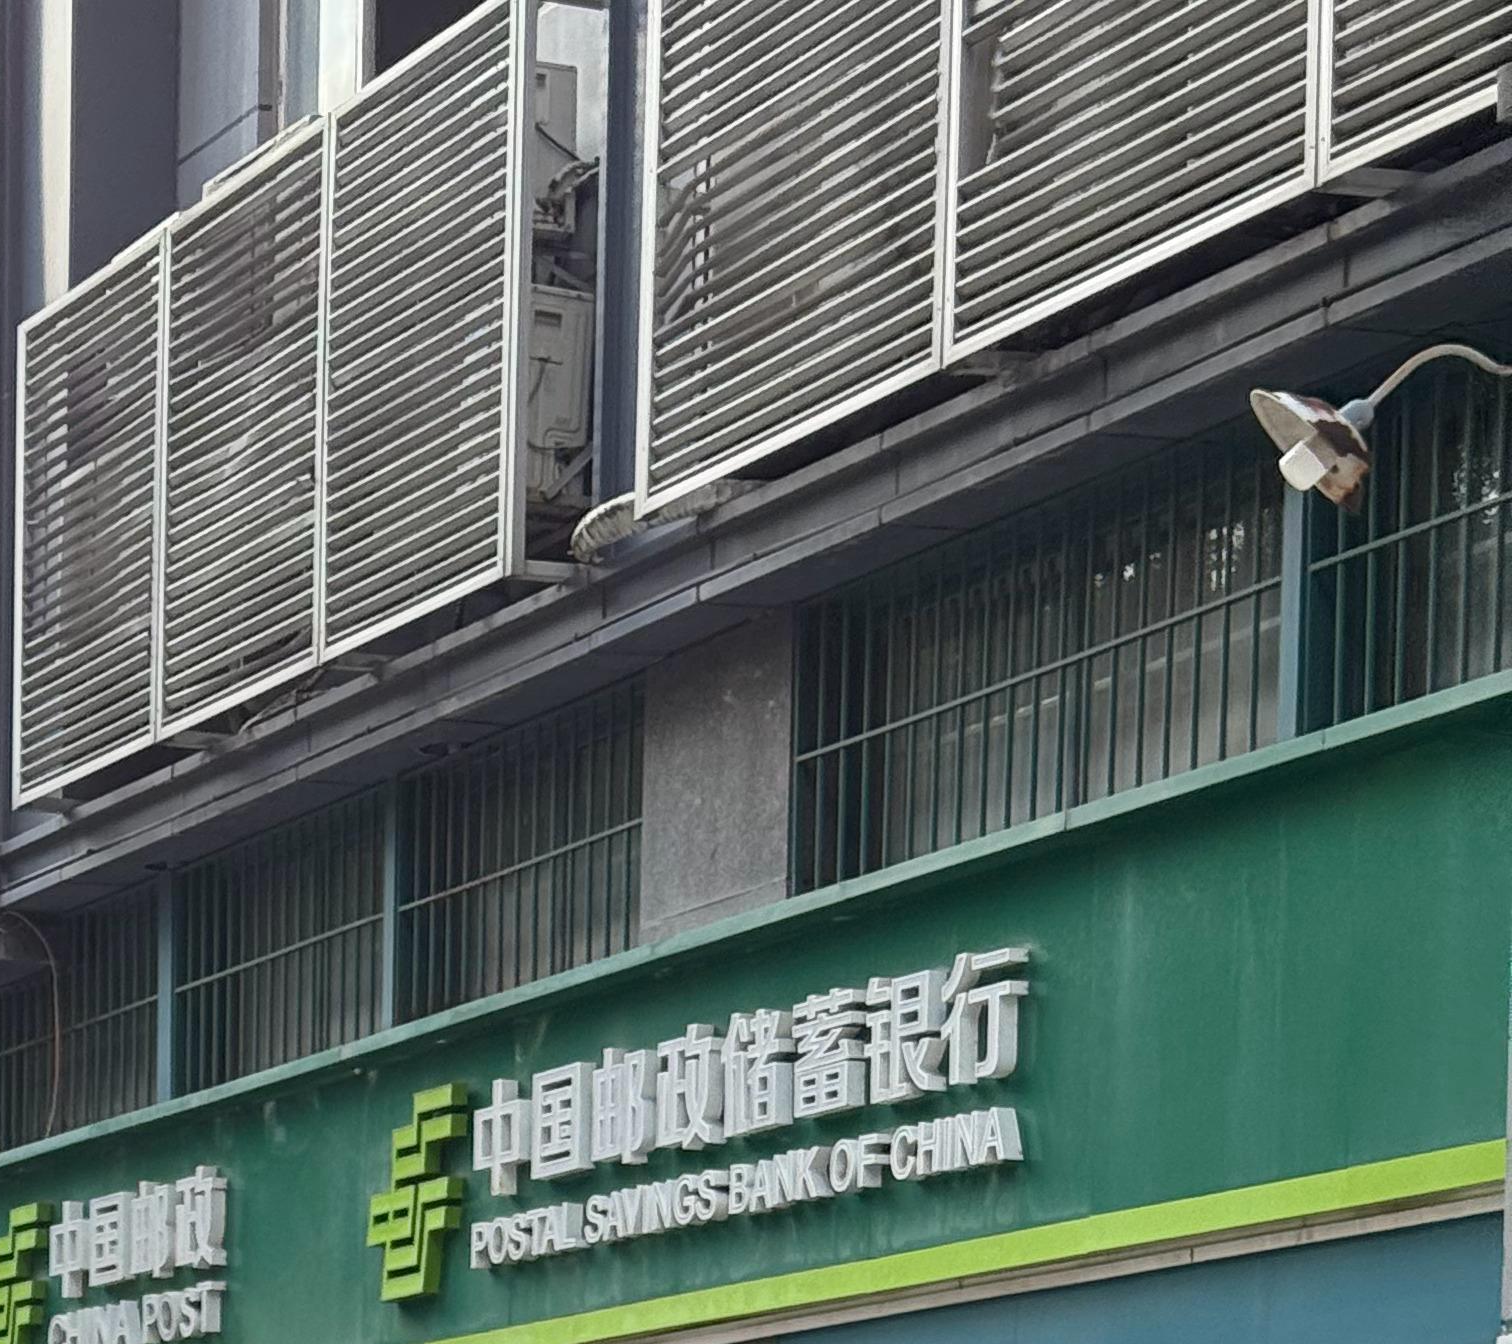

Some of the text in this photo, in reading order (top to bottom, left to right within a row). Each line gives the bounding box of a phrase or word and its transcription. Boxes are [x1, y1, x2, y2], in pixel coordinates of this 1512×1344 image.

[472, 947, 1029, 1196] 中国邮政储蓄银行
[49, 1165, 227, 1298] 中国邮政
[471, 1106, 1024, 1269] POSTAL SAVINGS BANK OF CHINA
[142, 1281, 226, 1344] POST
